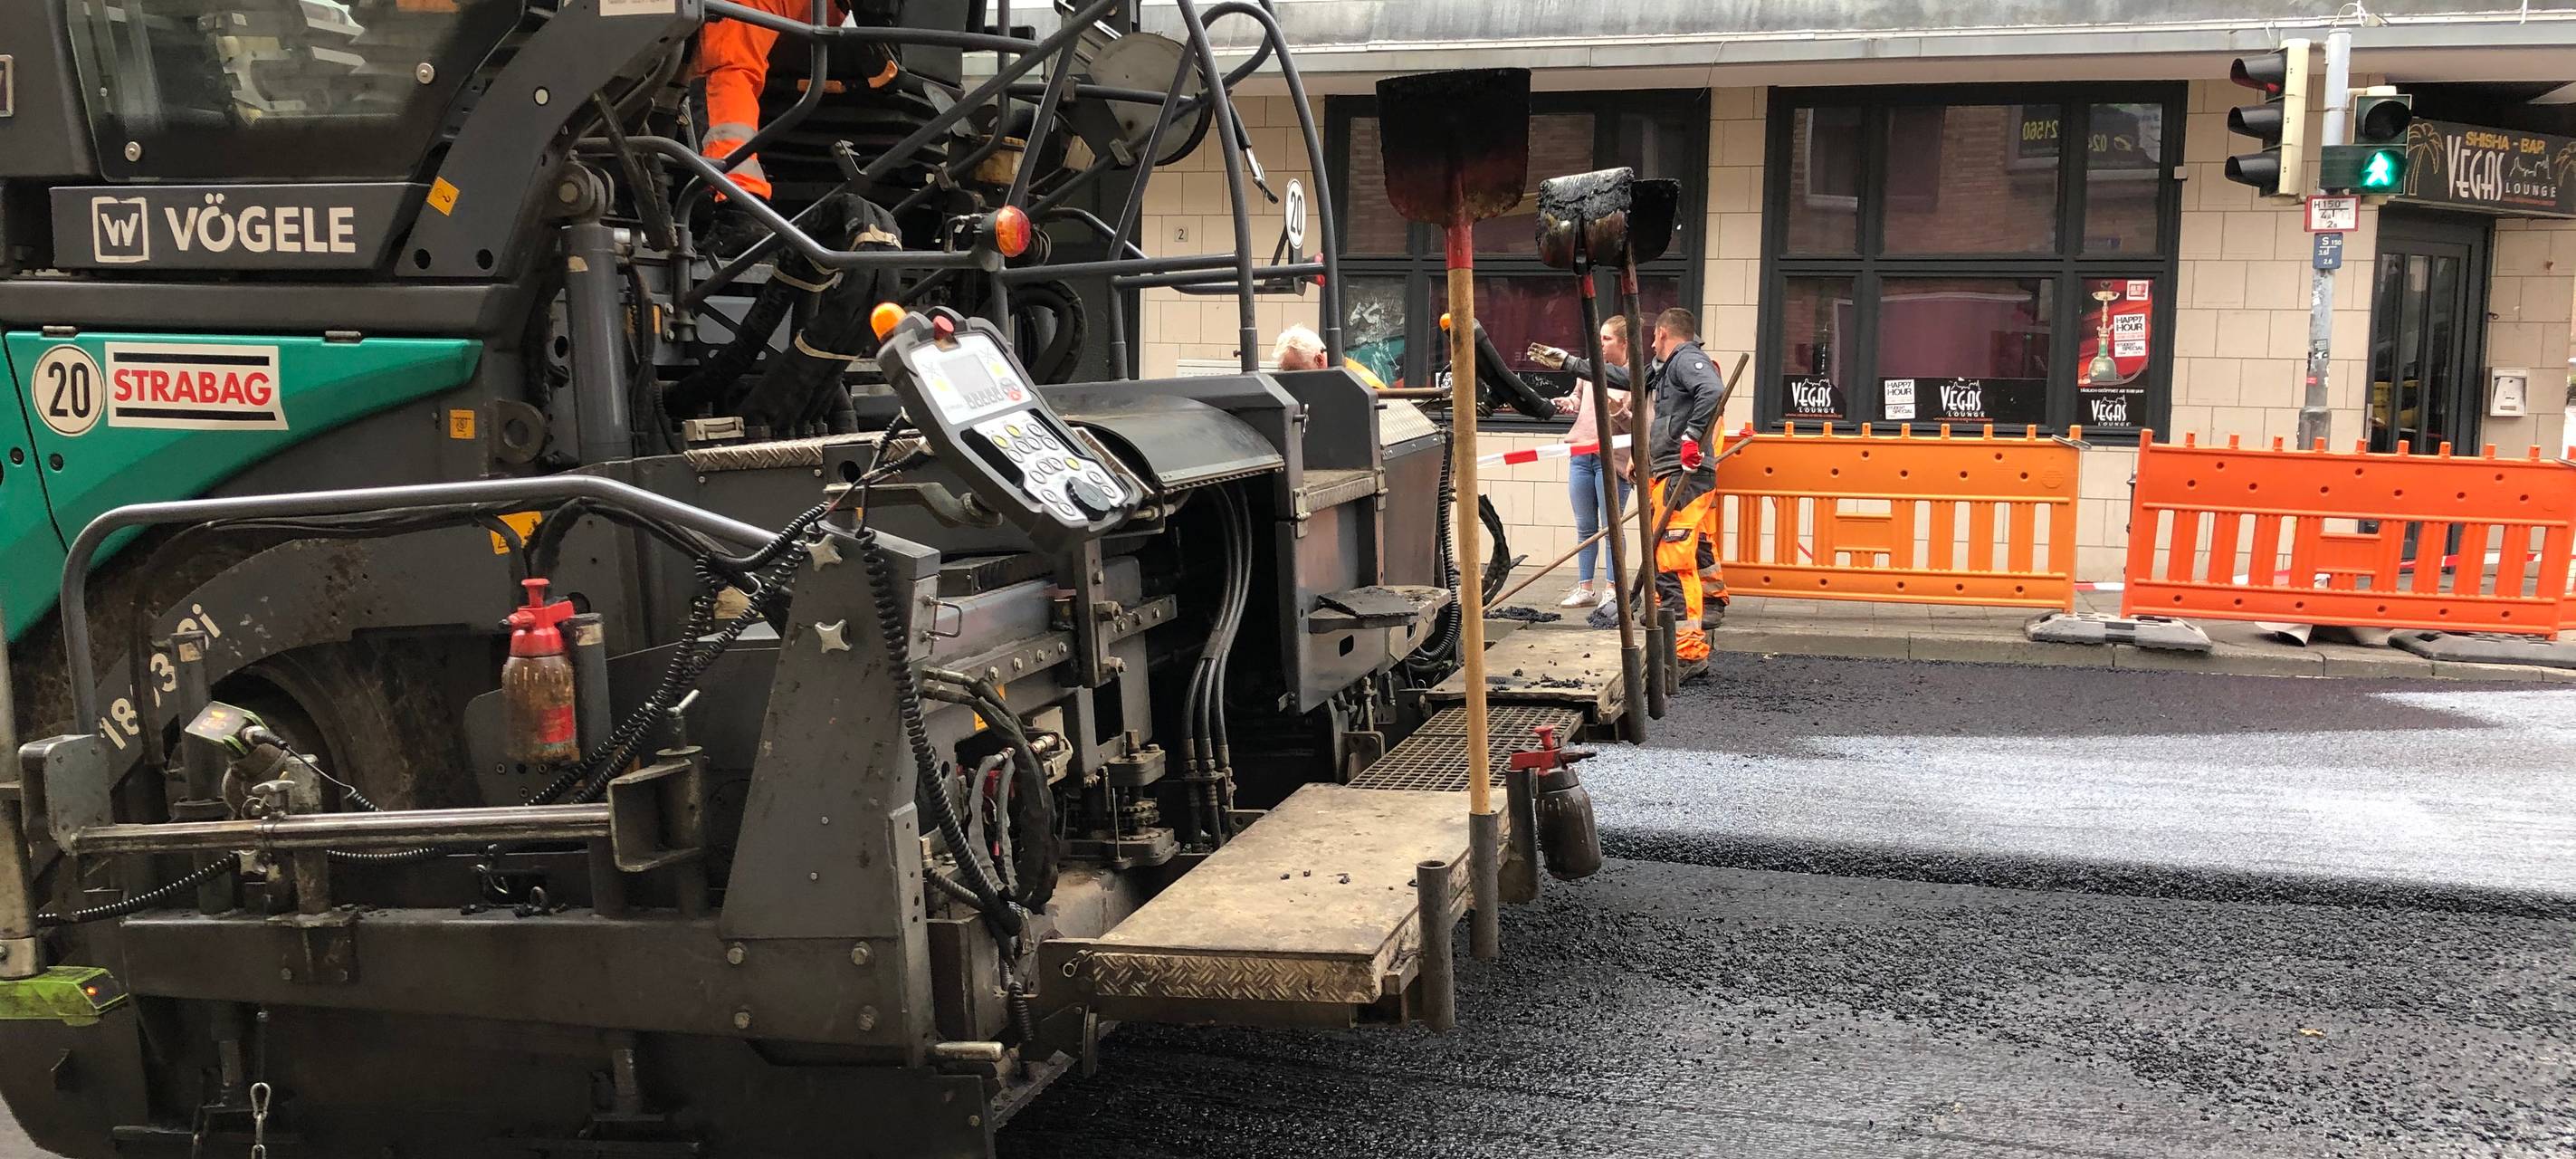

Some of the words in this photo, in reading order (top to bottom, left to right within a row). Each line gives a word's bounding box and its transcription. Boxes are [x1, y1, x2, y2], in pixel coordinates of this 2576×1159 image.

[2466, 131, 2509, 150] SHISHA
[2520, 138, 2546, 155] BAR
[2447, 135, 2505, 201] VEGAS
[2505, 182, 2556, 197] LOUNGE
[164, 192, 357, 254] VÖGELE
[1291, 190, 1303, 237] 20
[1178, 228, 1185, 240] 2
[2322, 236, 2330, 245] S
[2115, 315, 2143, 324] HAPPY
[2115, 322, 2143, 332] HOUR
[48, 361, 91, 418] 20
[114, 369, 272, 406] STRABAG
[1791, 381, 1833, 407] VEGAS
[1886, 381, 1913, 389] HAPPY
[1886, 388, 1913, 397] HOUR
[1940, 386, 1982, 412] VEGAS
[1798, 406, 1835, 414] LOUNGE
[2091, 399, 2127, 422] VEGAS
